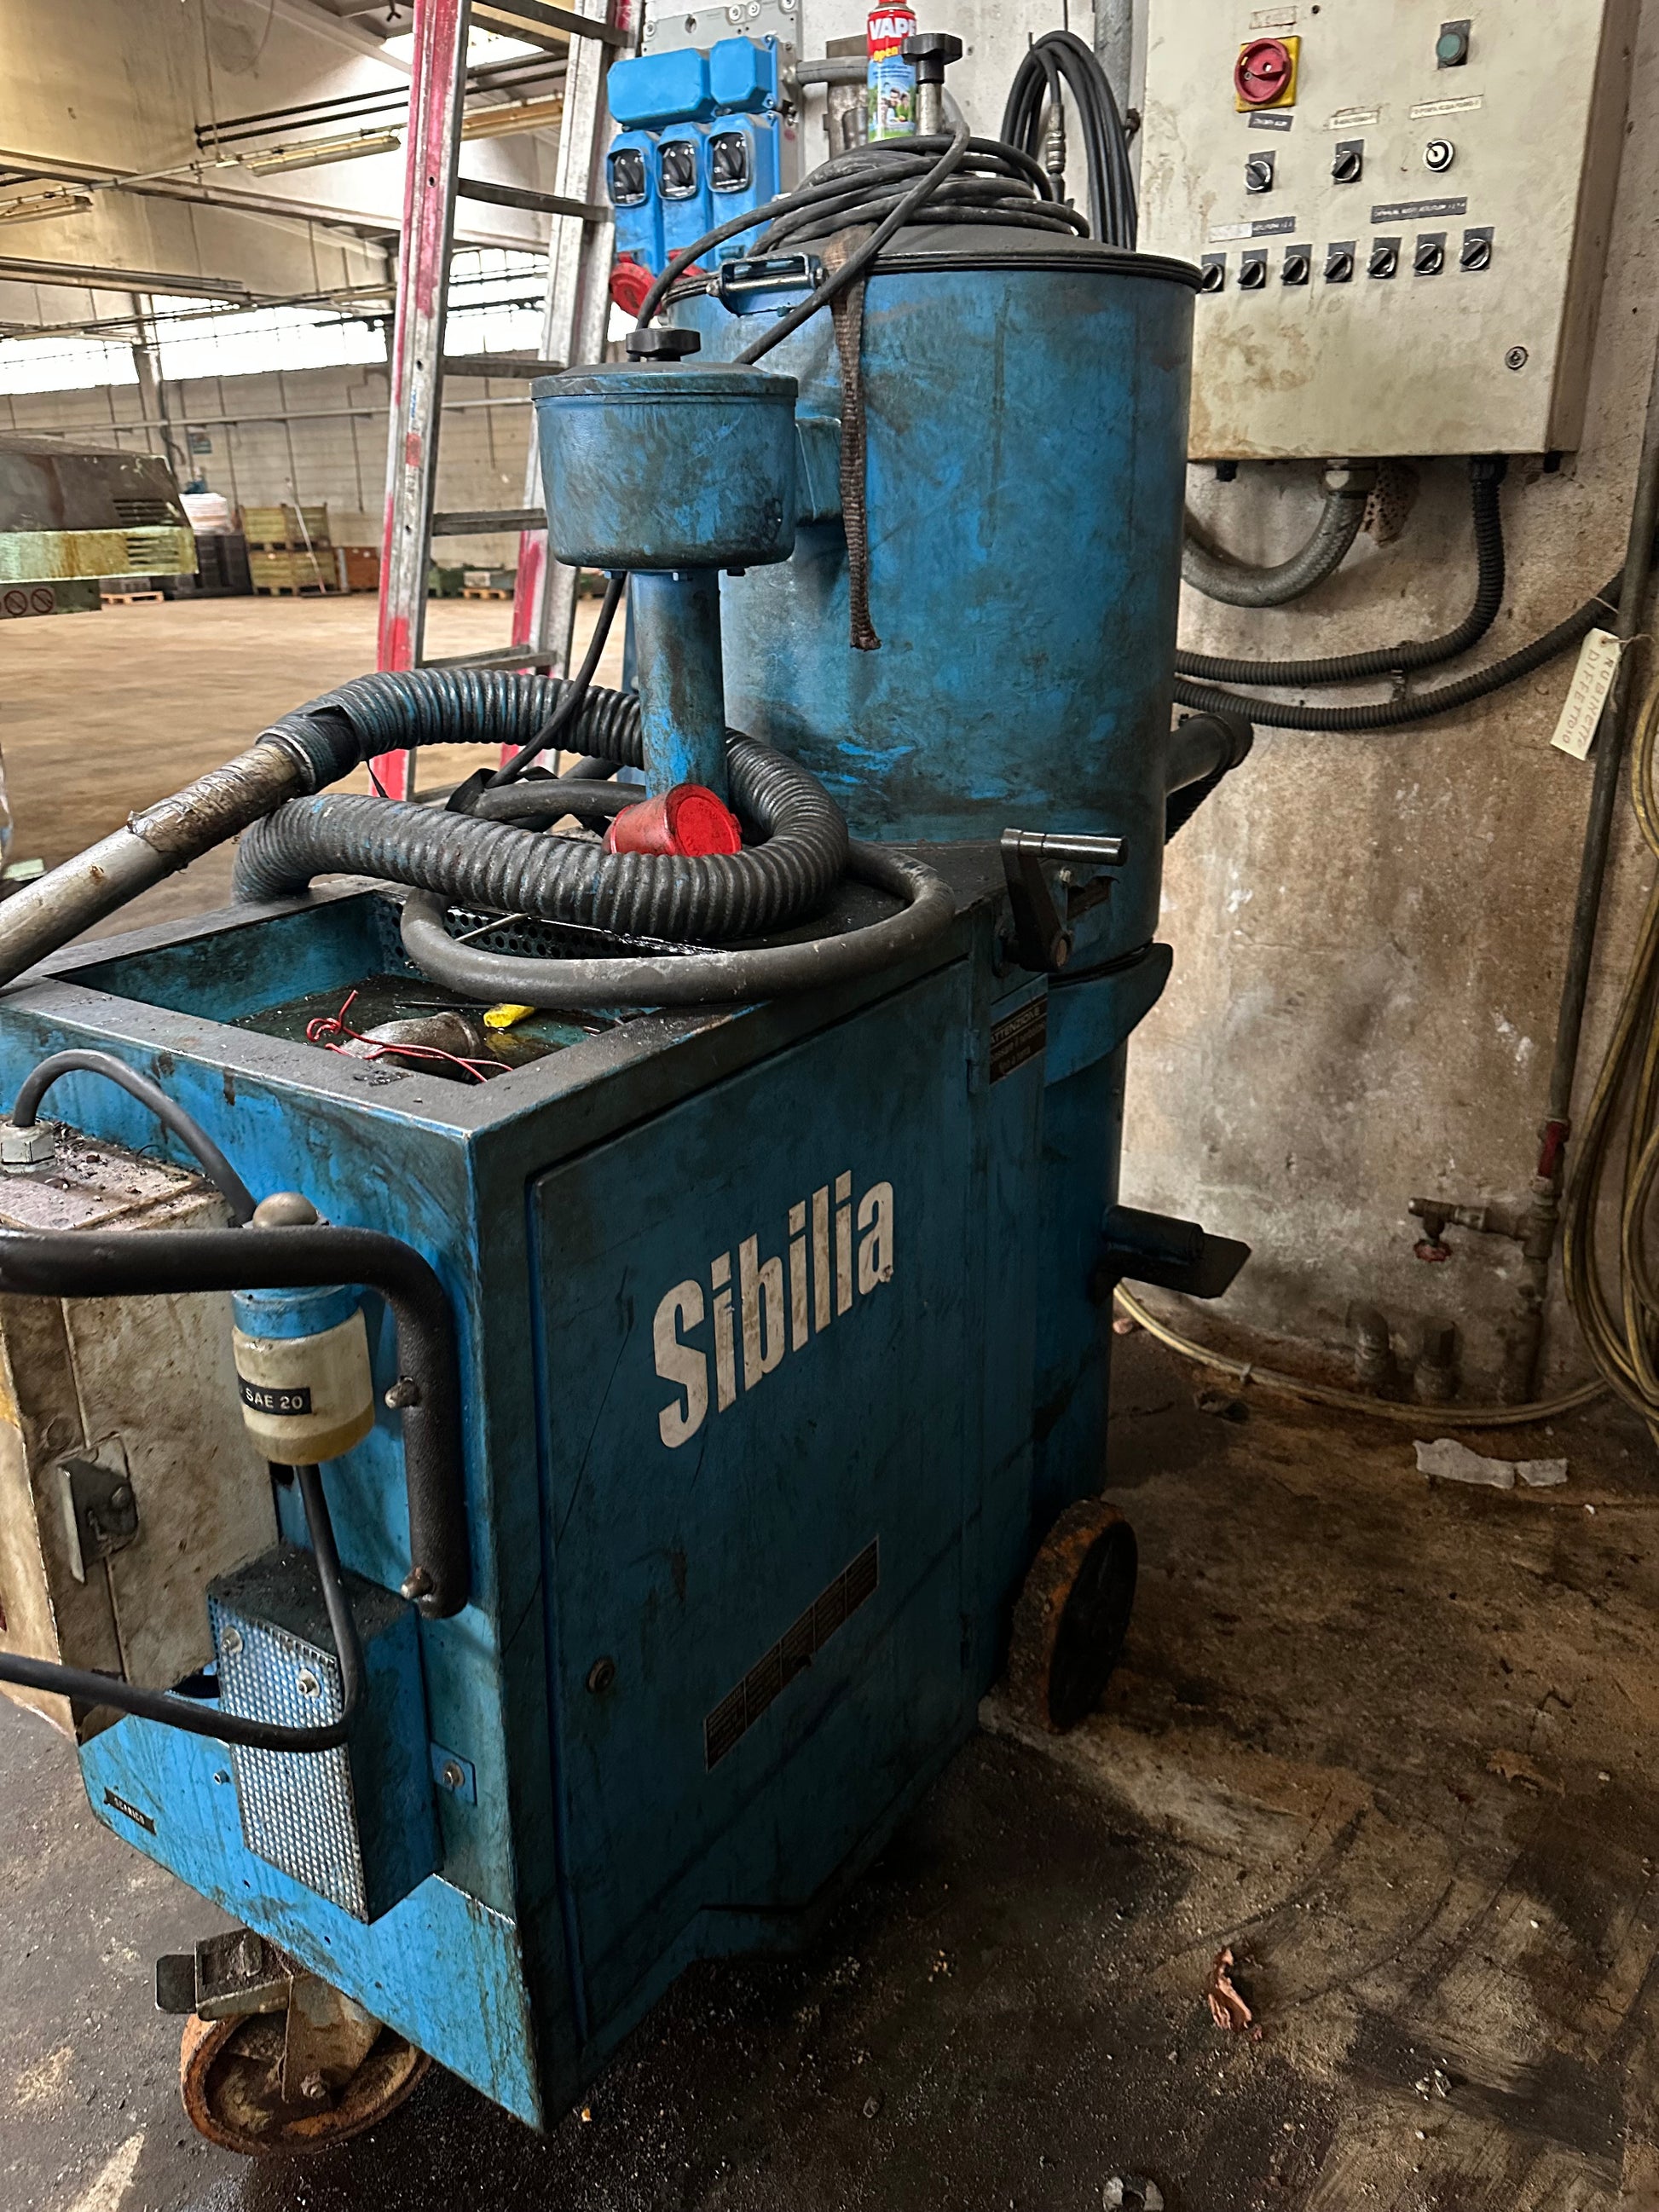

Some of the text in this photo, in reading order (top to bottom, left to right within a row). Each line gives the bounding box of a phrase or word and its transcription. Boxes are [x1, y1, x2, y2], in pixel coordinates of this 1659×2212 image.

[869, 17, 916, 40] VAPE
[653, 1170, 893, 1448] Sibilia
[246, 1387, 274, 1408] SAE
[280, 1395, 303, 1410] 20
